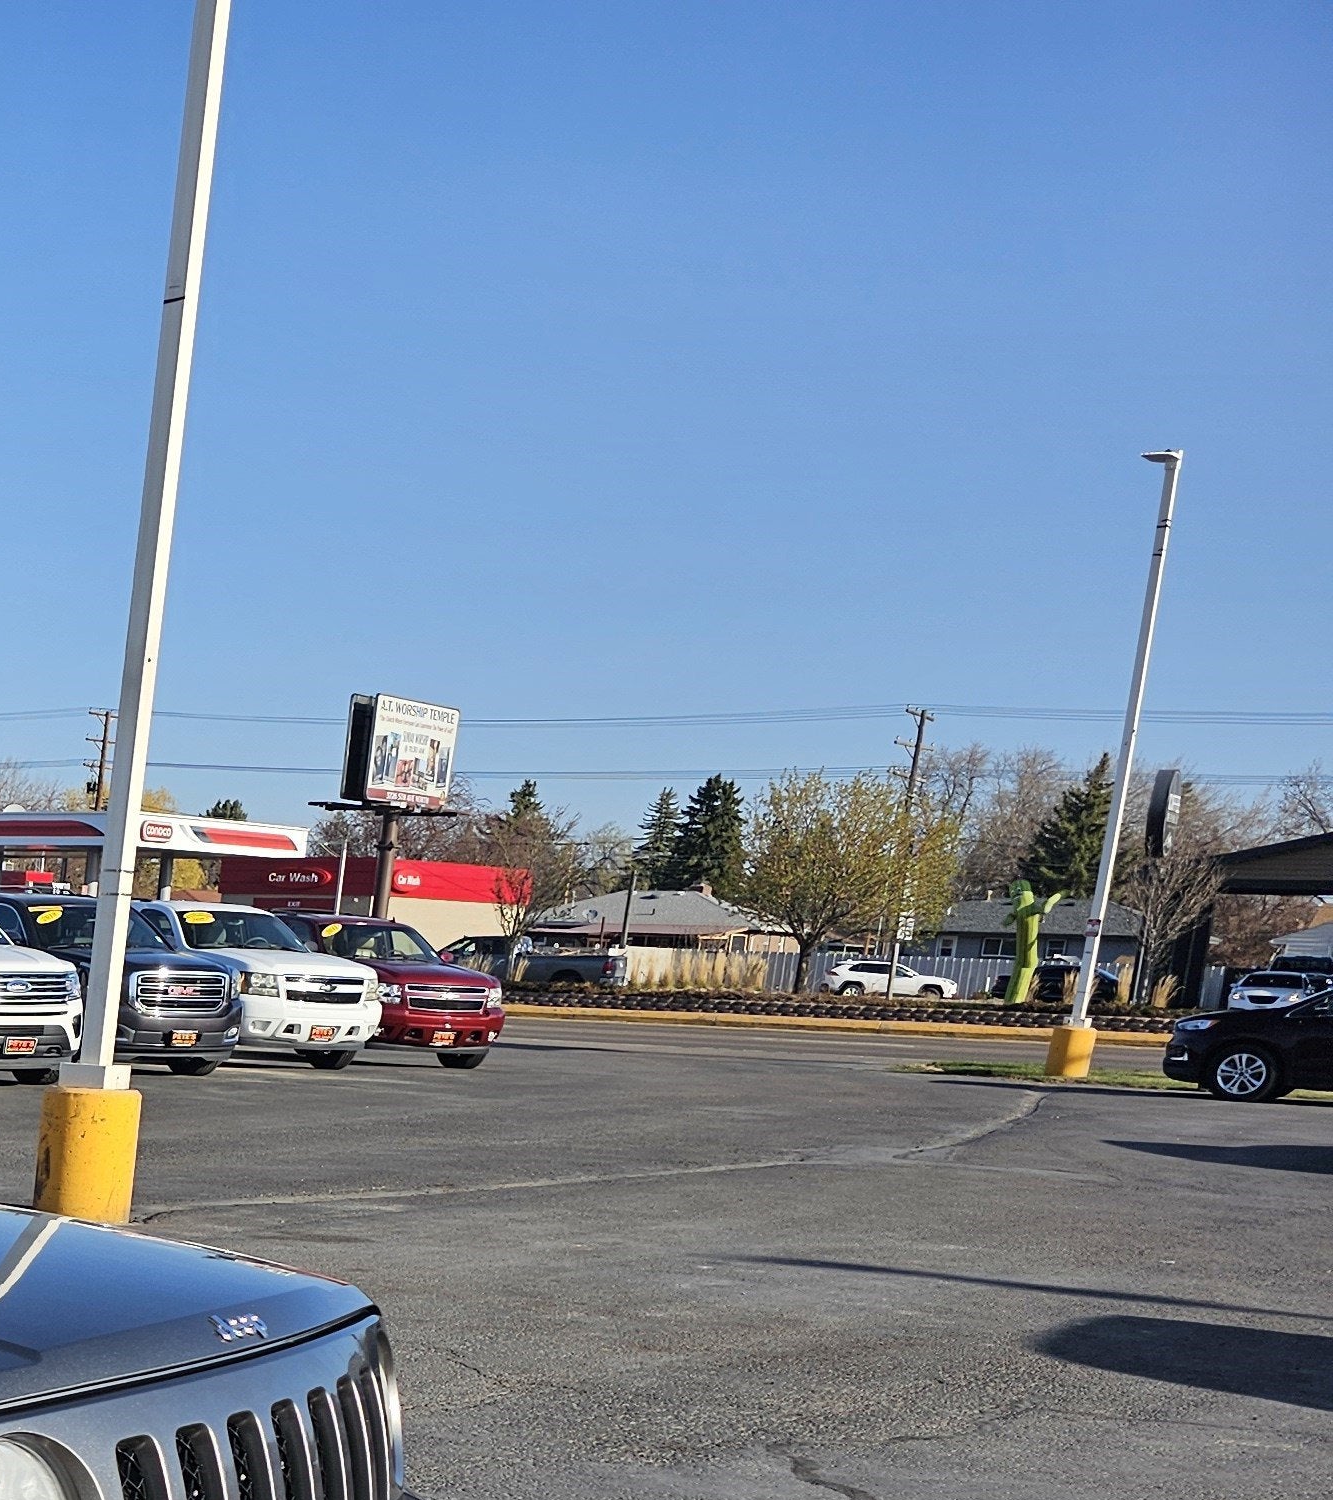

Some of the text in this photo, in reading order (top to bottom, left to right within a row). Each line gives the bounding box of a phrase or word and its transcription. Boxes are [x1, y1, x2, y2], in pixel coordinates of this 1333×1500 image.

[395, 701, 429, 717] WORSHIP
[429, 708, 456, 725] TEMPLE
[268, 871, 319, 883] Car Wash
